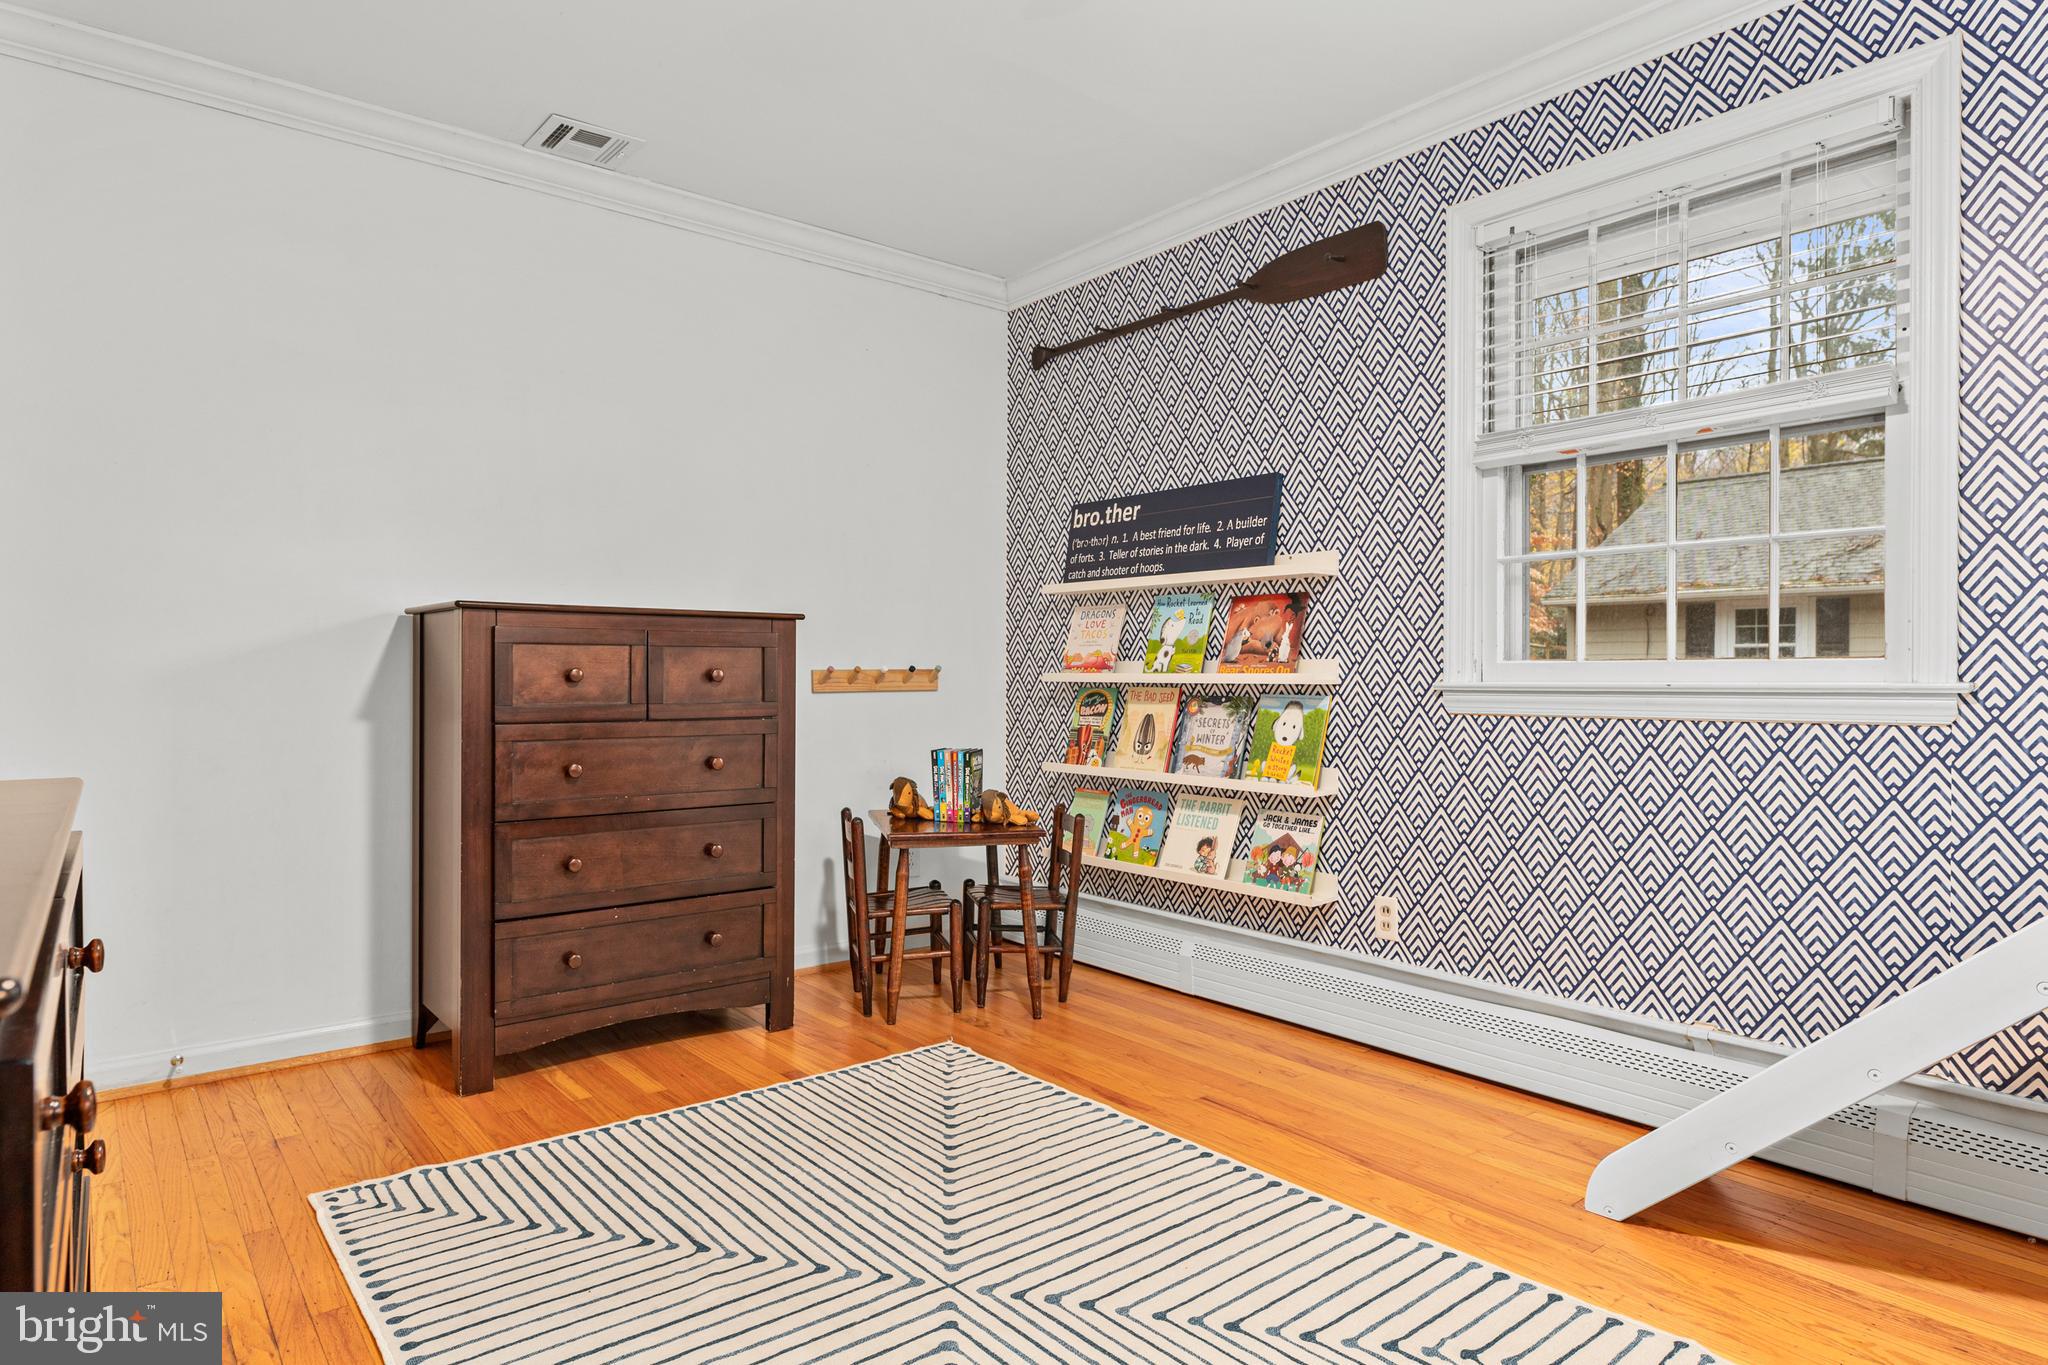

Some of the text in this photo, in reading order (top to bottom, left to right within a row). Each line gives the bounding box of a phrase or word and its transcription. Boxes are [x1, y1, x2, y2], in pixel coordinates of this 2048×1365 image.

[1073, 503, 1141, 528] bro.ther
[1111, 535, 1118, 544] n.
[1122, 533, 1128, 543] 1.
[1132, 532, 1138, 541] A
[1140, 530, 1156, 541] best
[1158, 525, 1181, 538] friend
[1183, 524, 1195, 535] for
[1197, 522, 1211, 534] life.
[1216, 521, 1224, 532] 2.
[1226, 520, 1233, 530] A
[1235, 516, 1268, 530] builder
[1070, 532, 1265, 564] of forts. 3. Teller of stories in the dark. 4. Player of
[1068, 562, 1165, 580] catch and shooter of hoops.
[1167, 596, 1186, 608] Rocket
[1080, 609, 1117, 620] DRAGONS
[1189, 612, 1204, 624] Read
[1085, 620, 1107, 629] LOVE
[1081, 629, 1108, 639] TACOS
[1220, 665, 1241, 674] Bear
[1242, 665, 1275, 674] Snores
[1276, 665, 1291, 674] On
[1131, 690, 1175, 703] THE BAD SEED
[1197, 717, 1230, 729] SECRETS
[1196, 734, 1226, 745] WINTER
[1121, 807, 1134, 818] MAN
[1181, 799, 1232, 816] THE RABBIT
[1176, 814, 1219, 830] LISTENED
[1263, 814, 1283, 823] JACK
[1292, 818, 1318, 828] JAMES
[1271, 823, 1298, 832] TOGETHER
